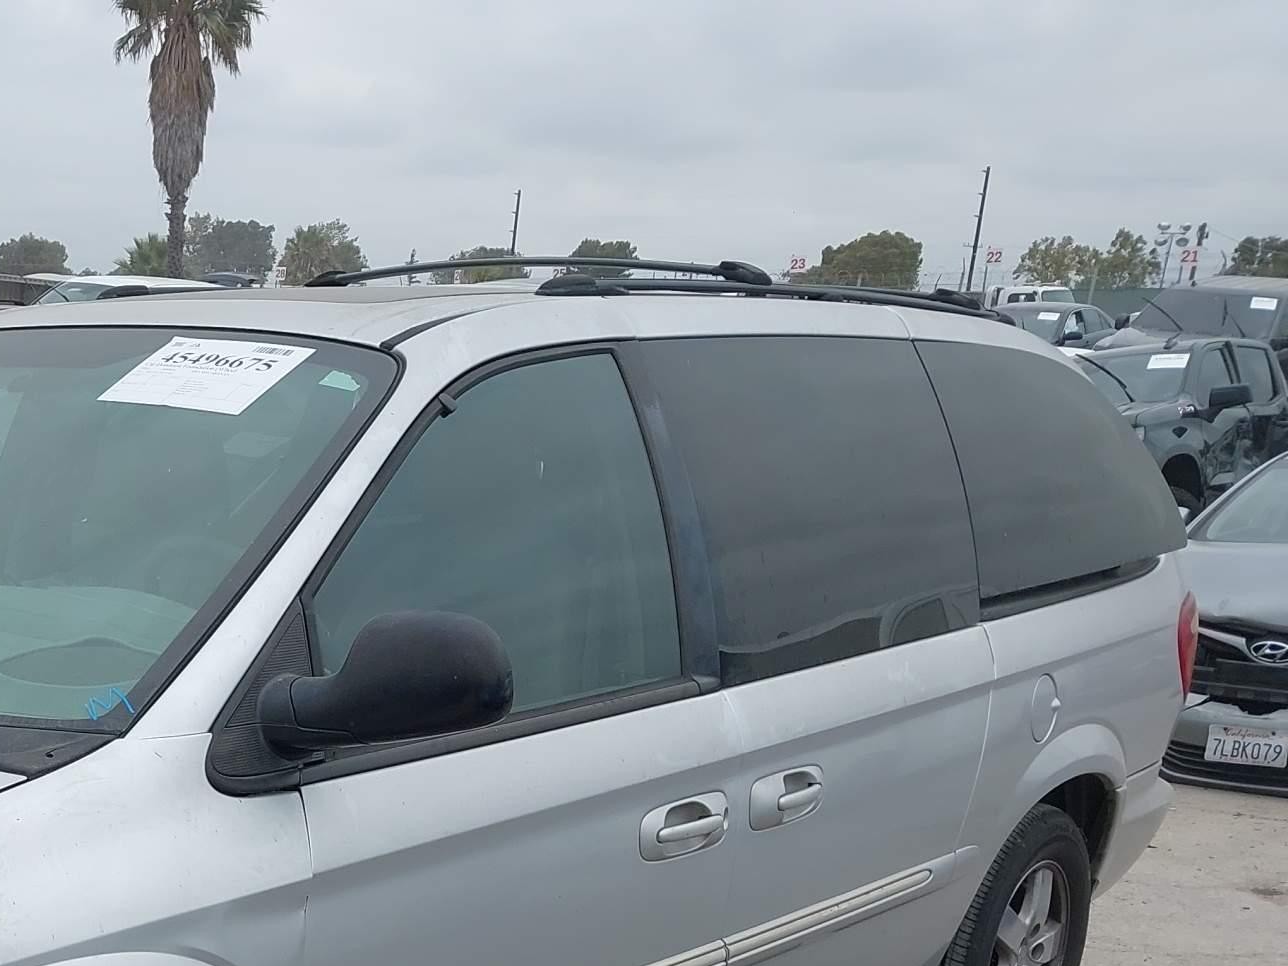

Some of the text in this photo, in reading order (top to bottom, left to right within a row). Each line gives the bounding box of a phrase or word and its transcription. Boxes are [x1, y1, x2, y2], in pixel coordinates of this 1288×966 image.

[986, 251, 1002, 263] 22
[1181, 250, 1198, 263] 21
[791, 258, 806, 270] 23
[161, 351, 280, 372] 45496675
[1225, 728, 1271, 740] California
[1213, 738, 1283, 762] 7LBK079
